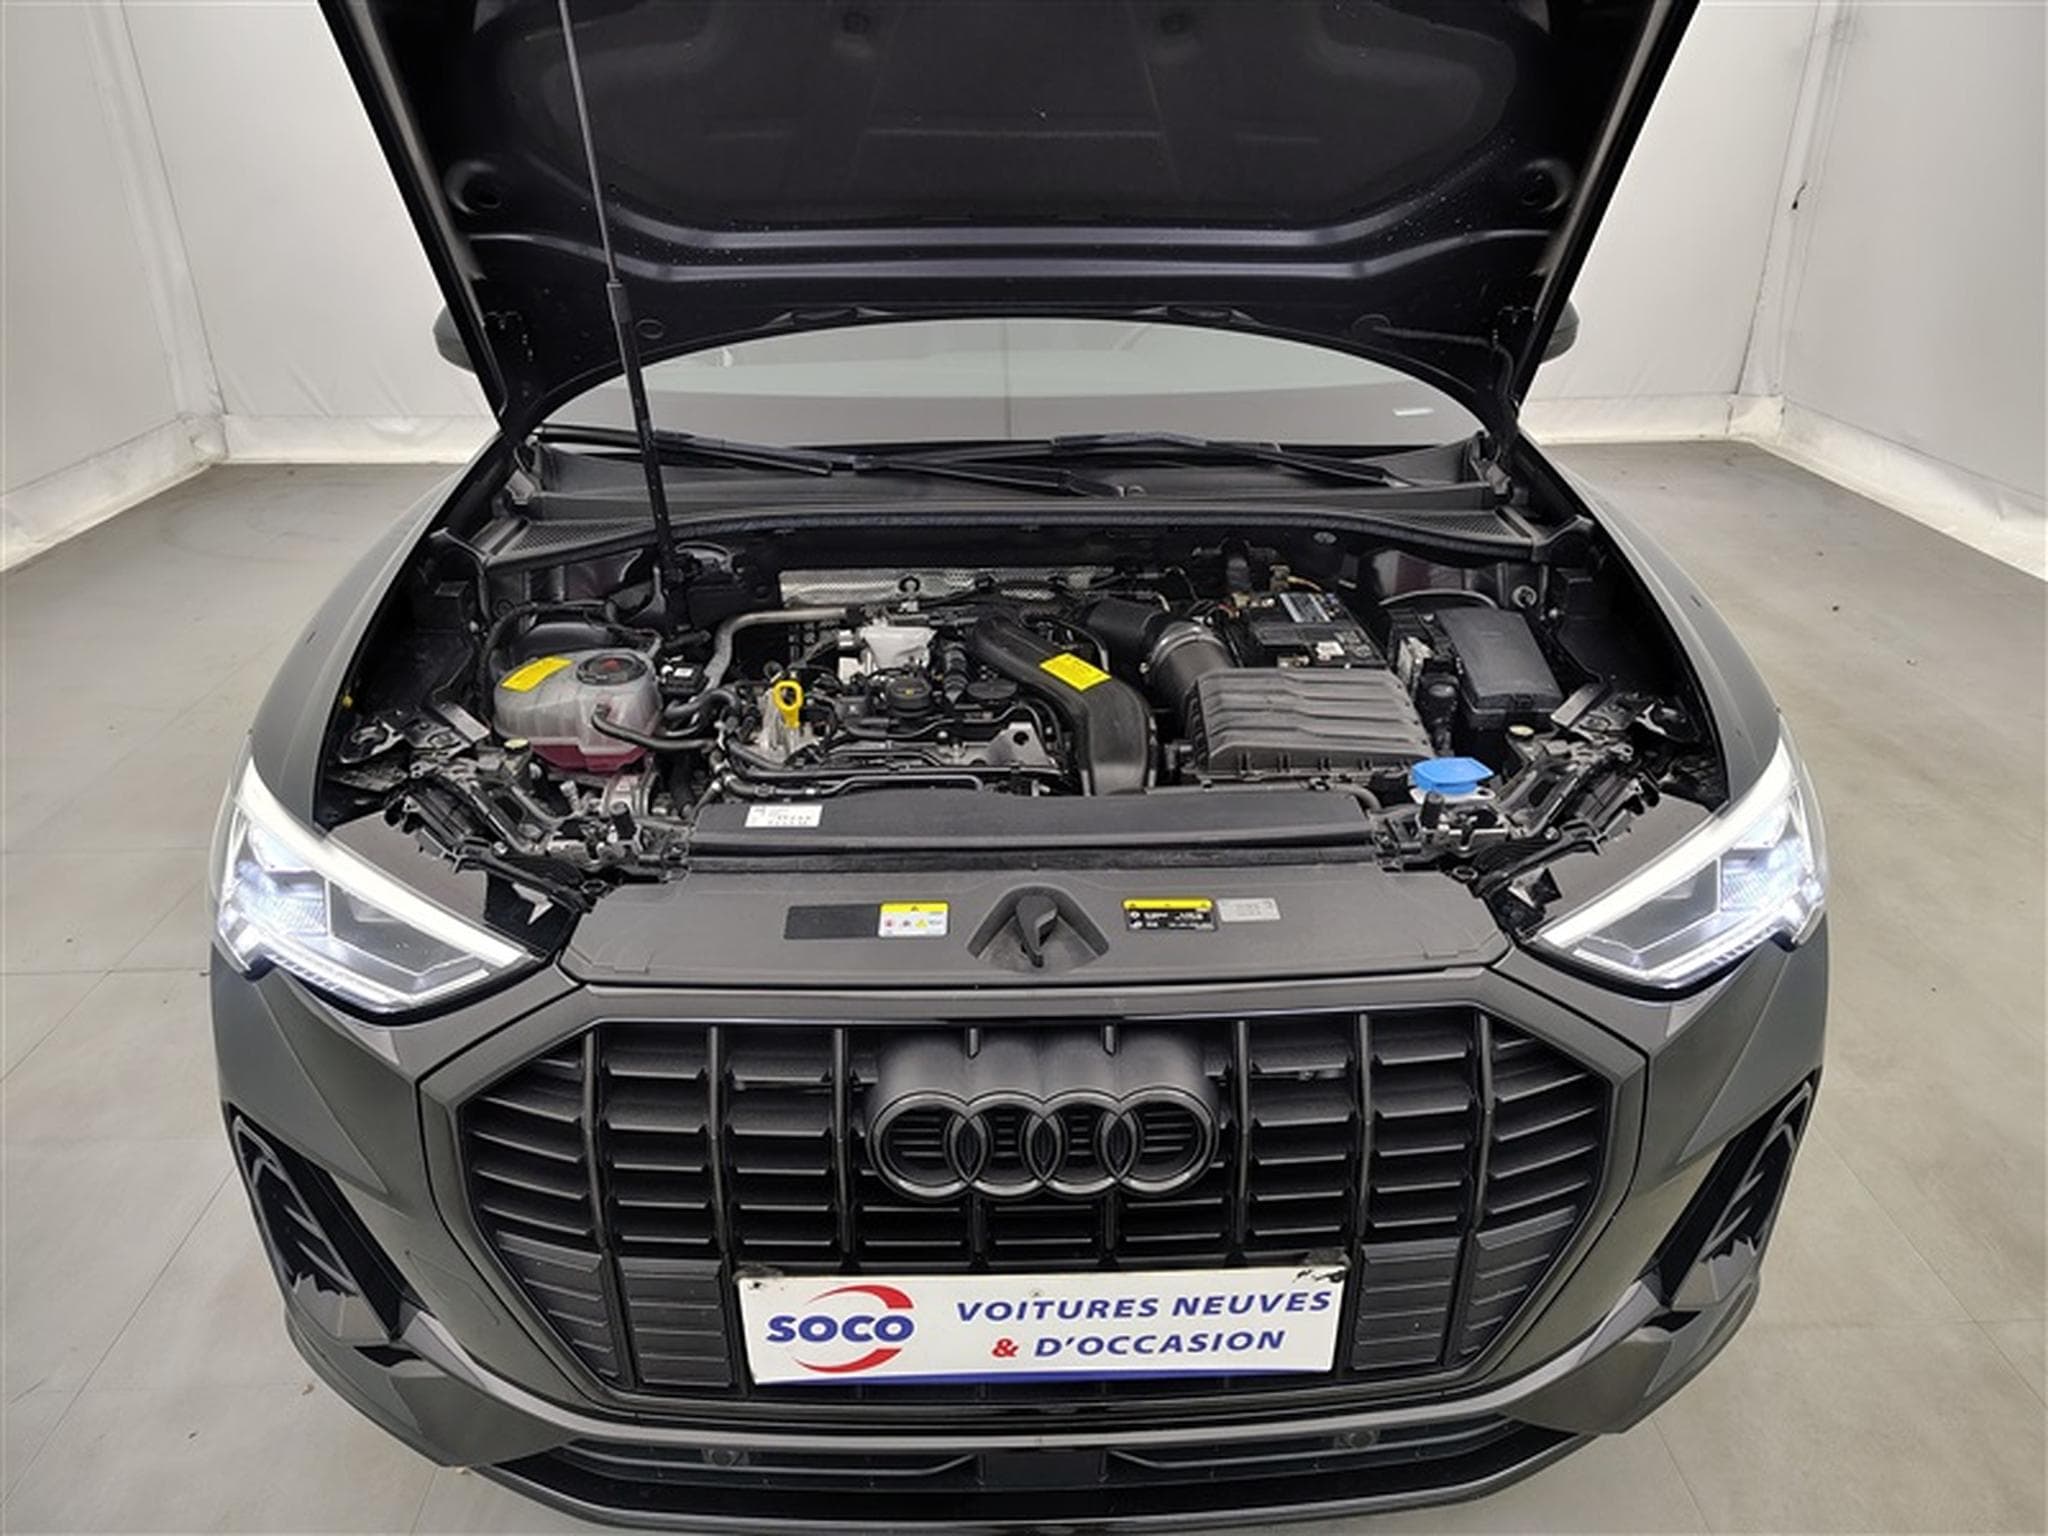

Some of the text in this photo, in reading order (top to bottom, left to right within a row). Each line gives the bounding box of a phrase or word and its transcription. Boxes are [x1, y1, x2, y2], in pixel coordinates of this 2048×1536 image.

[957, 1291, 1332, 1321] VOITURES NEUVES
[767, 1315, 914, 1343] SOCO
[991, 1330, 1285, 1358] & D'OCCASION
